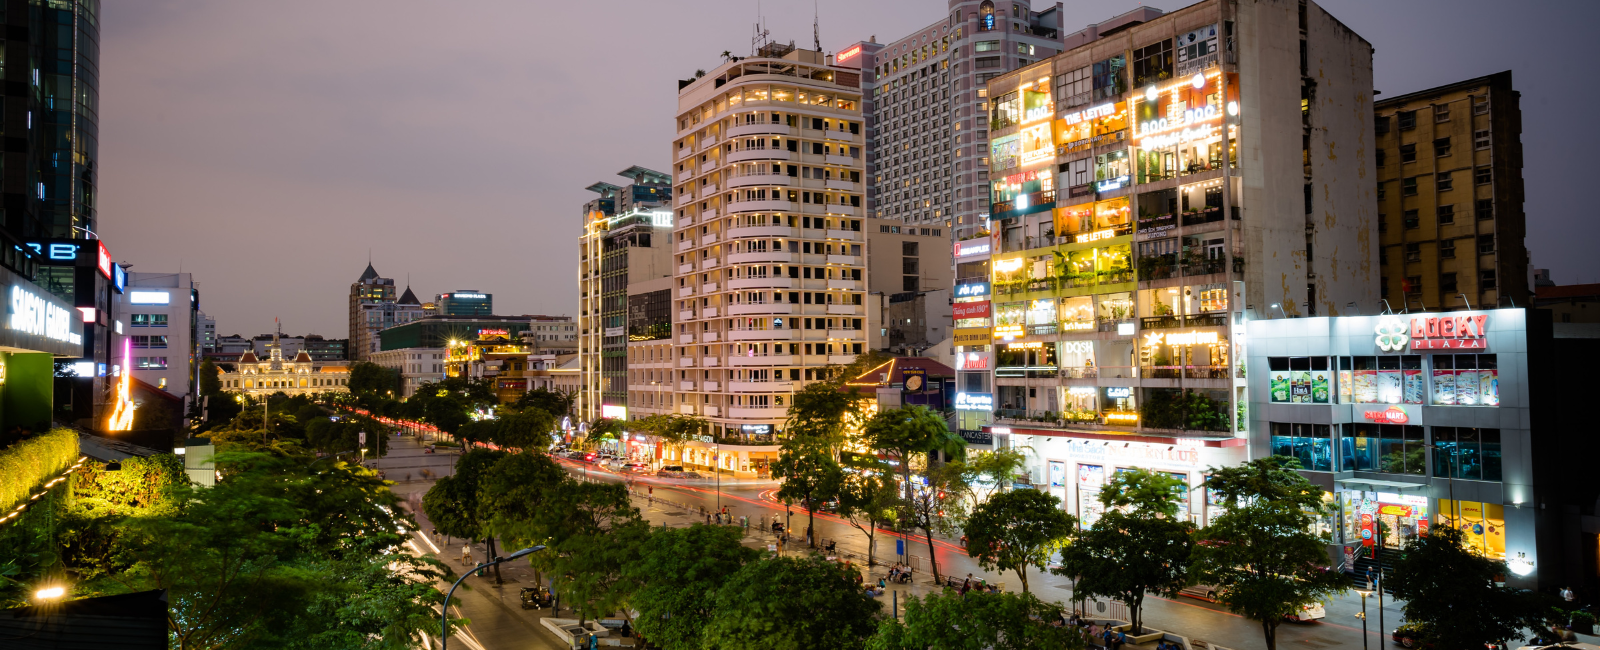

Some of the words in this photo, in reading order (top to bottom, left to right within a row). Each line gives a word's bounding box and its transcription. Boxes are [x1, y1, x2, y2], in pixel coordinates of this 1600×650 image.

[838, 46, 860, 62] Sheraton
[1026, 105, 1048, 120] BOO
[1064, 112, 1082, 126] THE
[1082, 102, 1115, 121] LETTER
[1185, 104, 1215, 123] BOO
[1141, 118, 1168, 134] BOO
[1076, 232, 1090, 244] THE
[1091, 228, 1115, 241] LETTER
[970, 284, 985, 296] spa
[12, 285, 46, 336] SAIGON
[1411, 314, 1488, 338] LUCKY
[1066, 342, 1093, 354] DOSH
[1415, 339, 1480, 349] PLAZA
[960, 430, 992, 441] LANCASTER
[1068, 440, 1084, 453] Nhà
[1085, 442, 1105, 454] Sách
